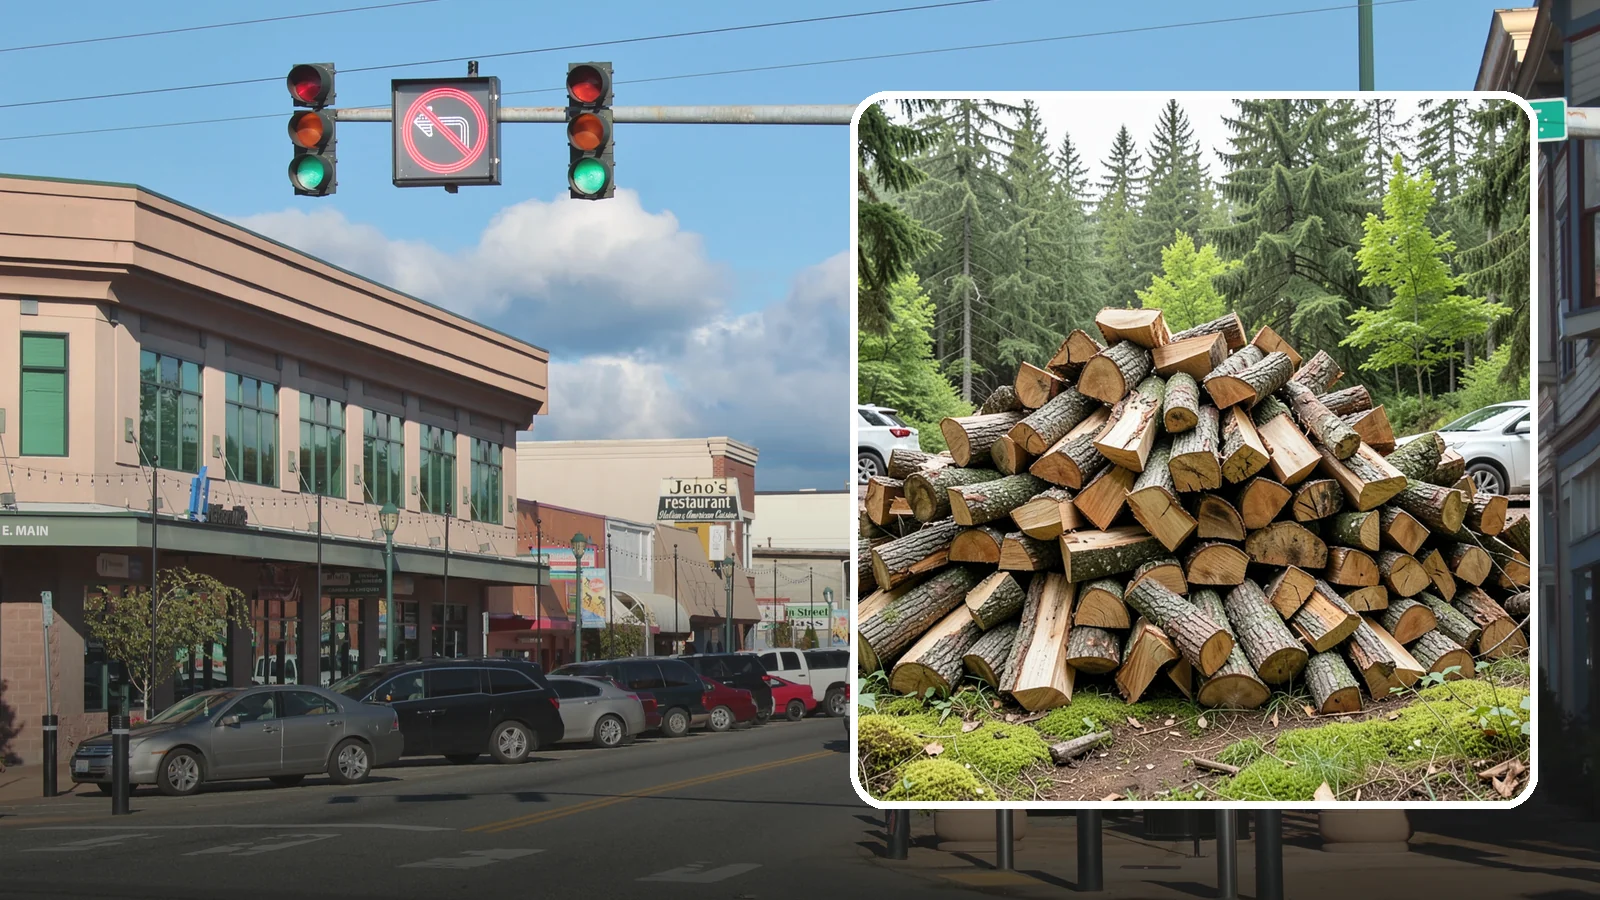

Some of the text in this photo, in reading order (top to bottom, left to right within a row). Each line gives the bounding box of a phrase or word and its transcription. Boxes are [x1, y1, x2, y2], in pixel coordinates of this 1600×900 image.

[670, 480, 727, 495] Jeno's
[665, 496, 731, 509] restaurant
[658, 510, 681, 519] Italian
[686, 510, 715, 519] American
[715, 510, 737, 519] Cuisine
[2, 525, 49, 536] E. MAIN
[797, 607, 828, 617] Street
